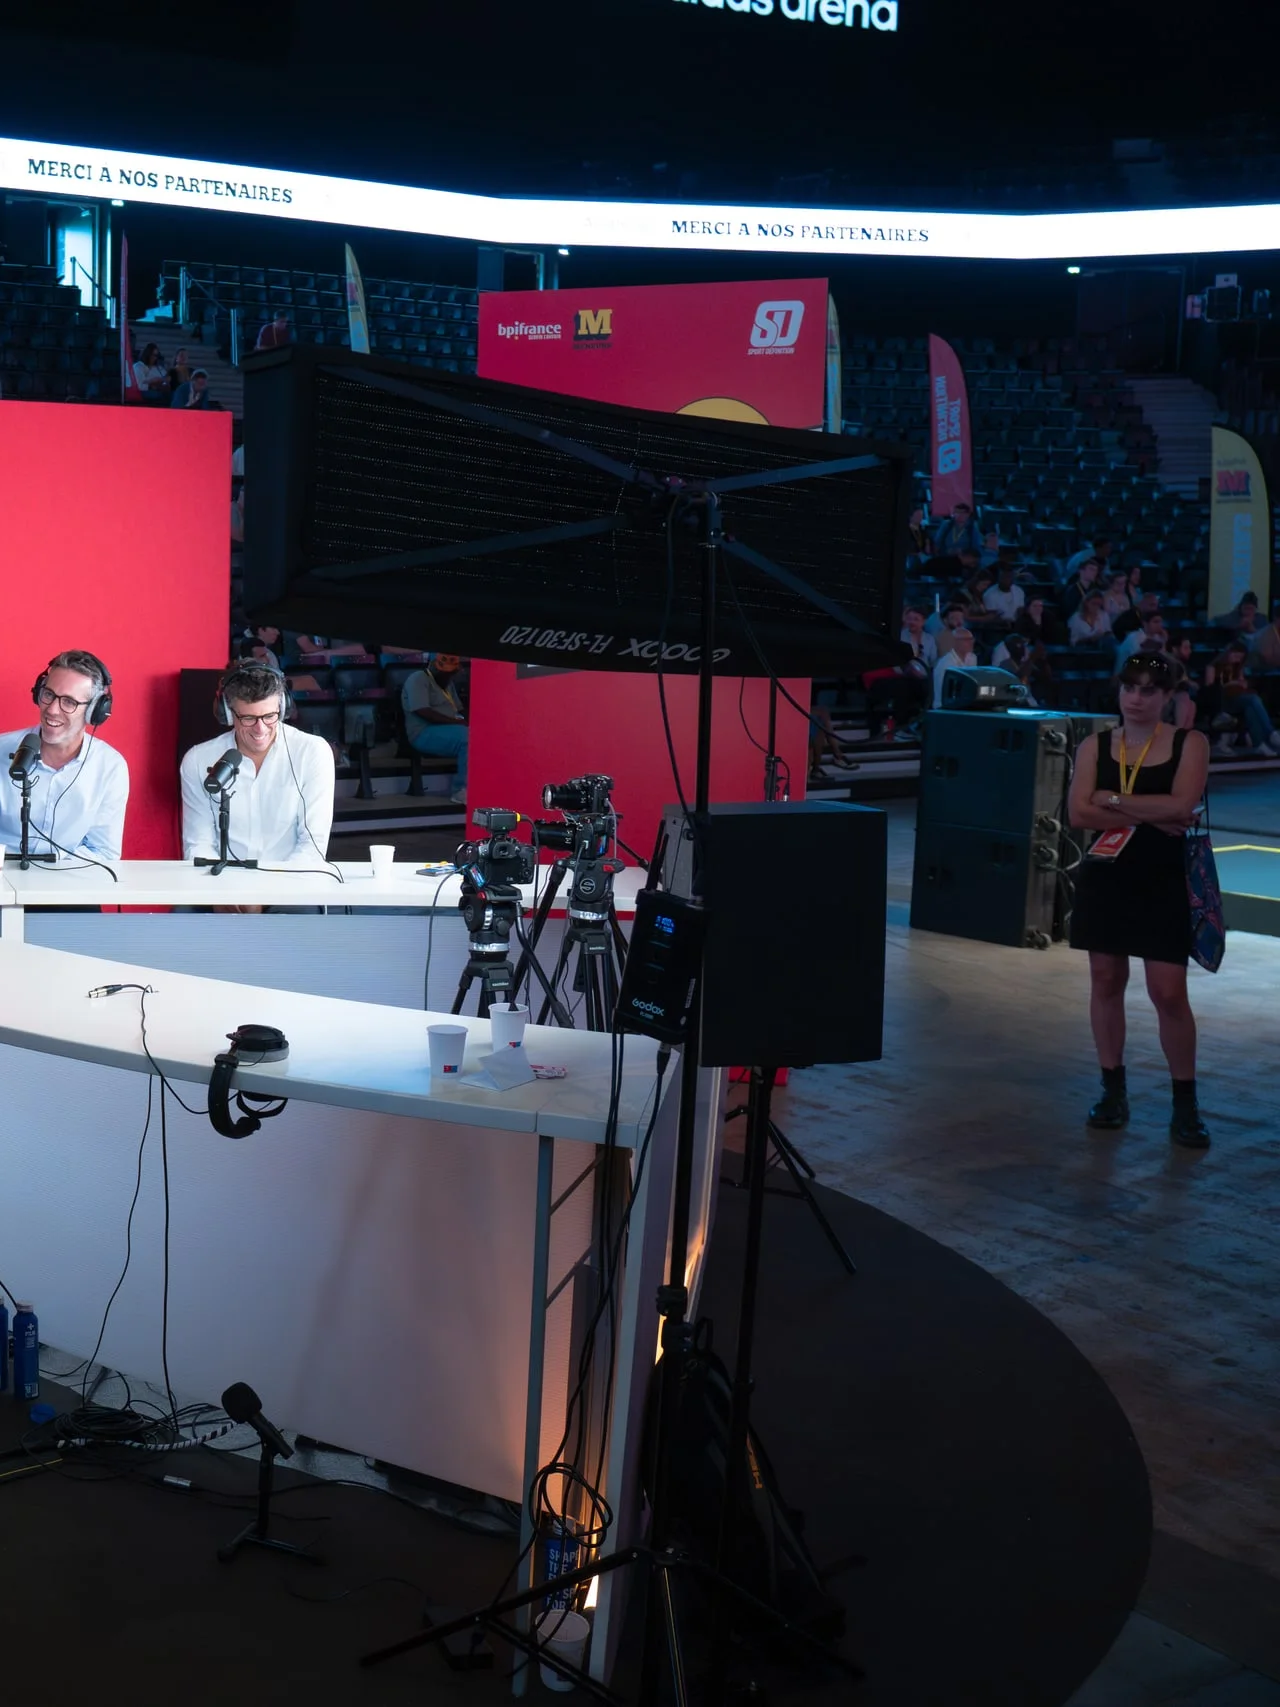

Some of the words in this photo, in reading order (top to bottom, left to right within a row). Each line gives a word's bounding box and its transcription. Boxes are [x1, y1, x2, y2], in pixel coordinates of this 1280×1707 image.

[780, 0, 898, 31] arena
[27, 158, 93, 180] MERCI
[119, 169, 158, 188] NOS
[165, 175, 293, 203] PARTENAIRES
[671, 220, 731, 235] MERCI
[757, 223, 794, 238] NOS
[800, 225, 929, 242] PARTENAIRES
[498, 321, 561, 339] bpifrance
[632, 998, 665, 1017] Godox
